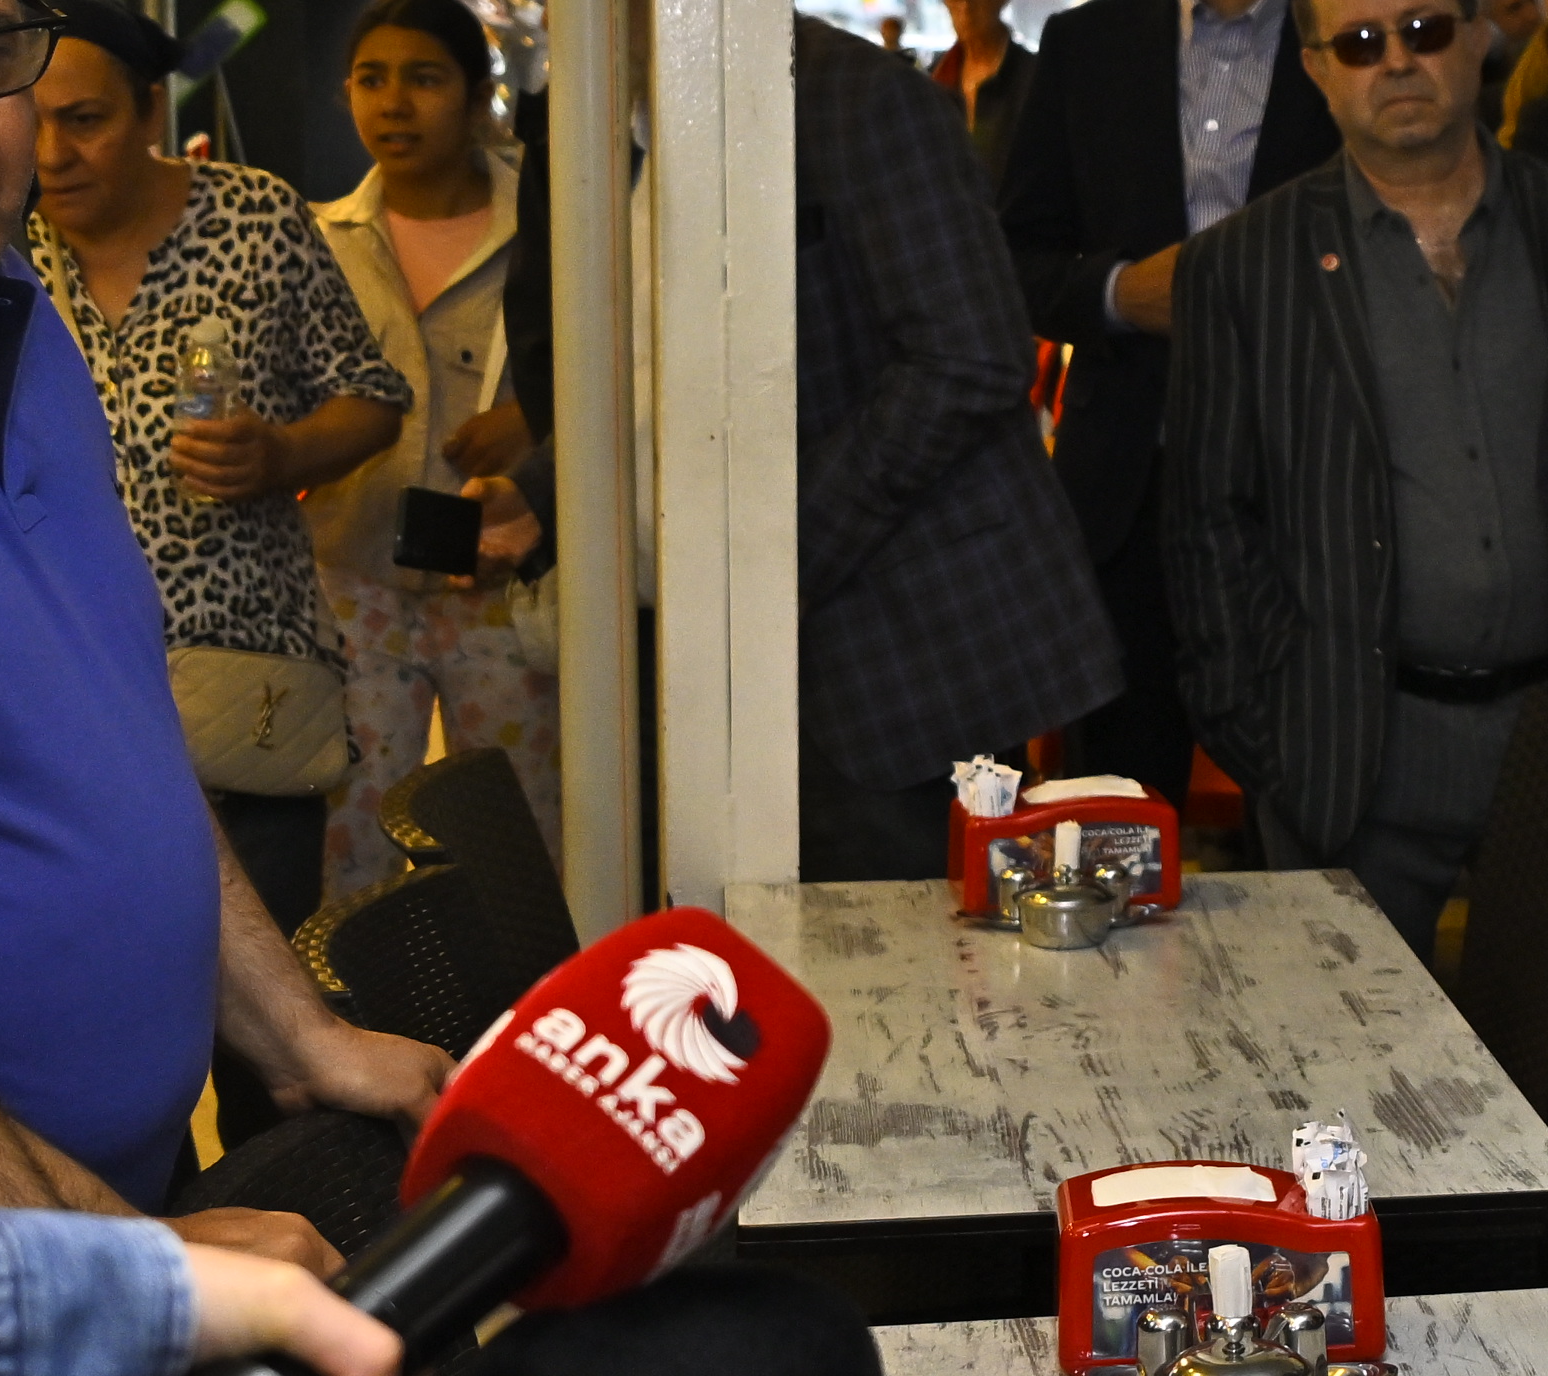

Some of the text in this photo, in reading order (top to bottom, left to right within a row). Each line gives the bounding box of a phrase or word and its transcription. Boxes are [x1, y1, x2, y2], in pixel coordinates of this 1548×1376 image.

[532, 1007, 707, 1163] anka
[1102, 1261, 1208, 1278] COCA-COLA İLE
[1103, 1277, 1159, 1292] LEZZETİ
